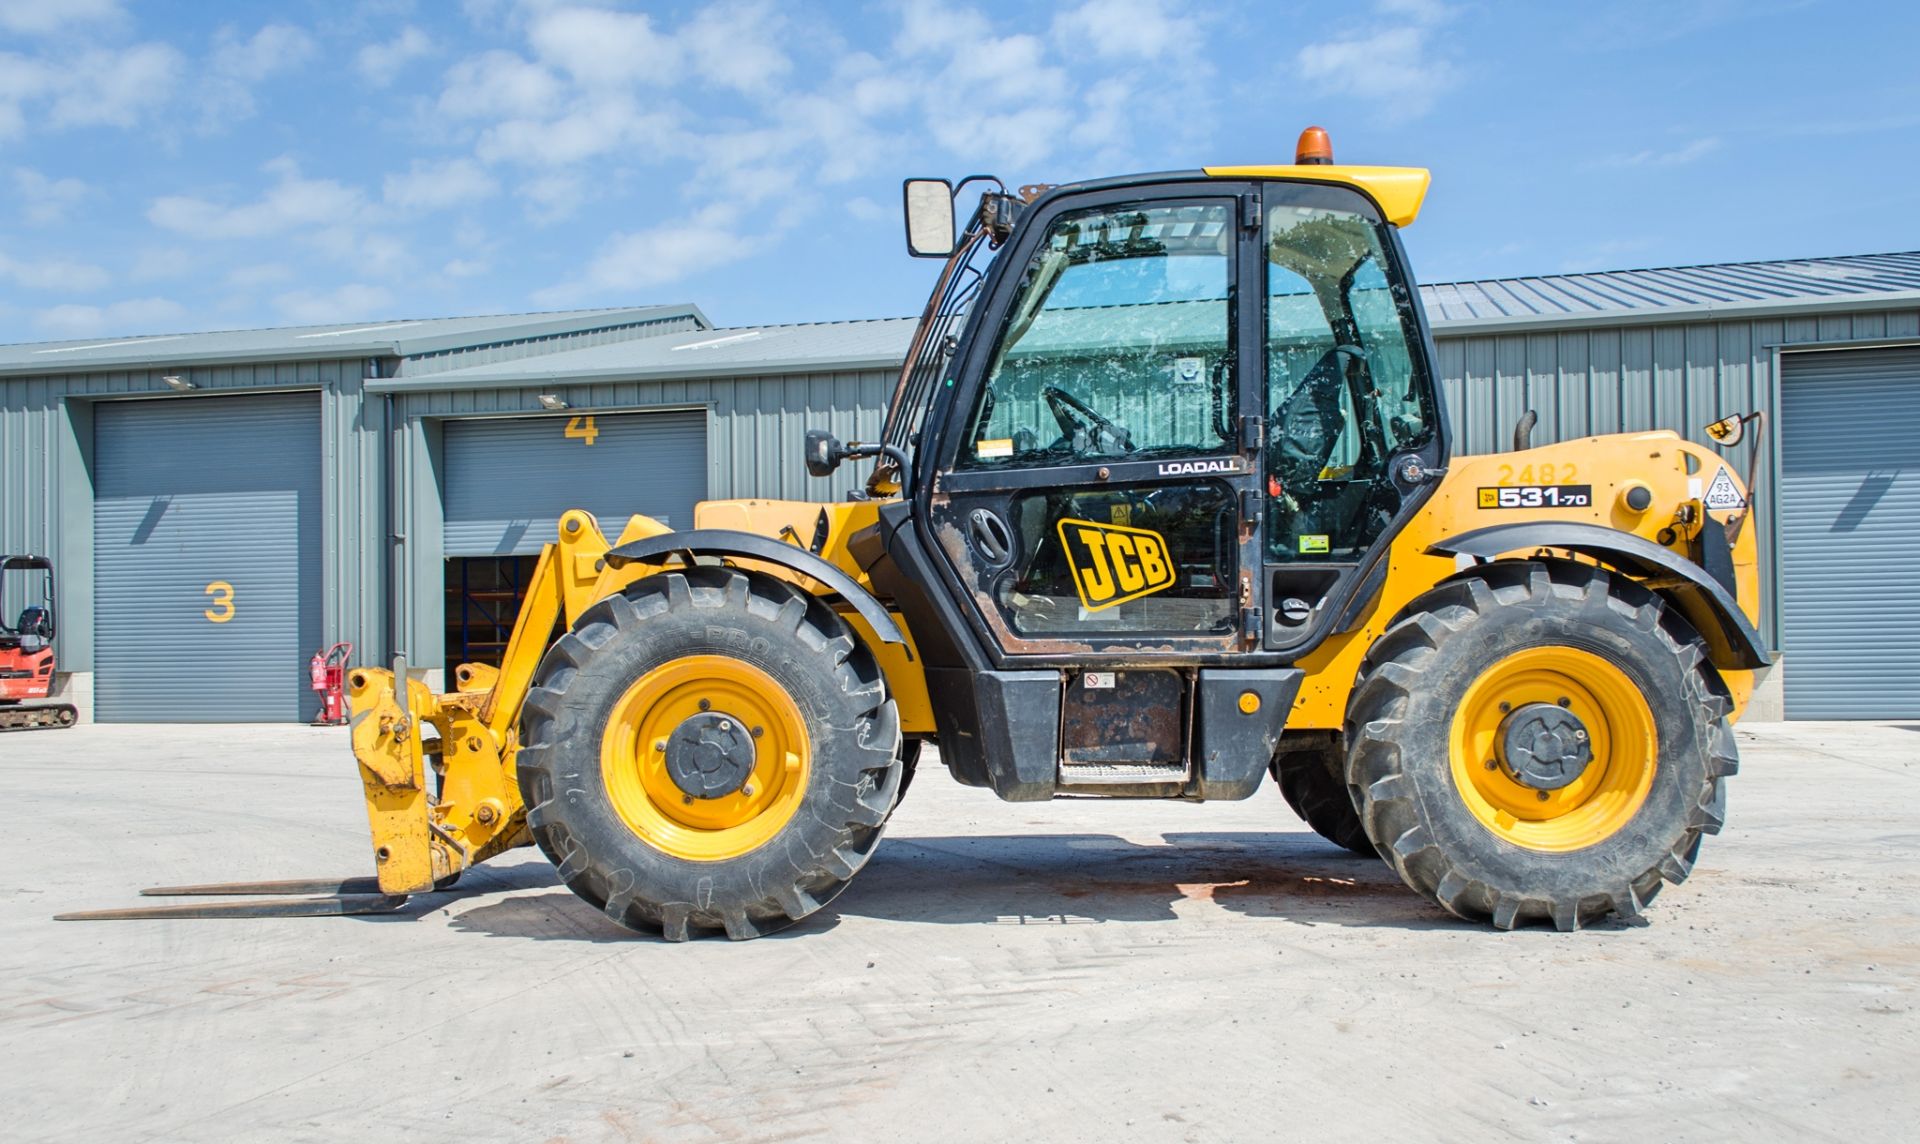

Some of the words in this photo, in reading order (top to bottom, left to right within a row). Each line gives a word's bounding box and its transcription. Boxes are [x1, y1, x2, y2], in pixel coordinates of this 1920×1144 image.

[564, 416, 599, 446] 4
[1158, 460, 1240, 475] LOADALL
[1497, 463, 1578, 487] 2482
[1716, 482, 1730, 493] 93
[1078, 528, 1168, 602] JCB
[205, 580, 236, 623] 3
